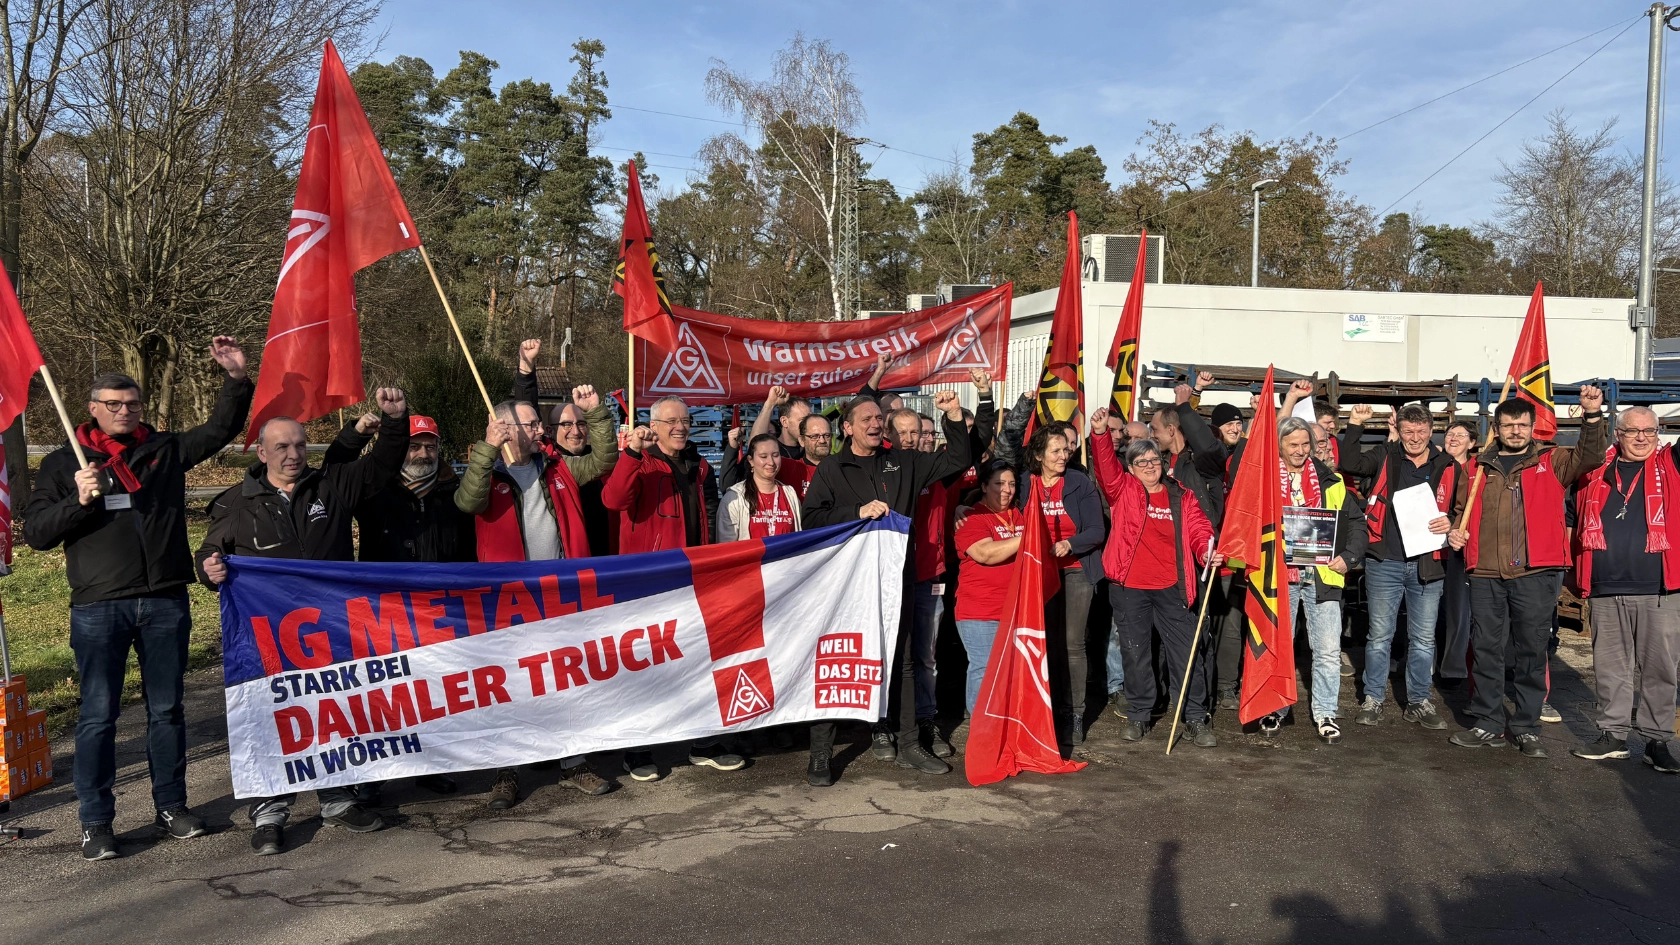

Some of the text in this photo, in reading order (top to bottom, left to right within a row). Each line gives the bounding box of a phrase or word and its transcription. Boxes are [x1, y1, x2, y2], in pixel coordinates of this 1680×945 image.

[1348, 314, 1366, 322] SAB
[743, 327, 920, 363] Warnstreik
[747, 371, 806, 386] unser
[810, 367, 862, 389] gutes
[251, 568, 615, 678] IG METALL
[820, 638, 858, 655] WEIL
[270, 655, 412, 704] STARK BEI
[274, 618, 684, 756] DAIMLER TRUCK
[819, 664, 883, 682] DAS JETZ
[819, 685, 869, 706] ZÄHLT.
[284, 732, 423, 785] IN WÖRTH
